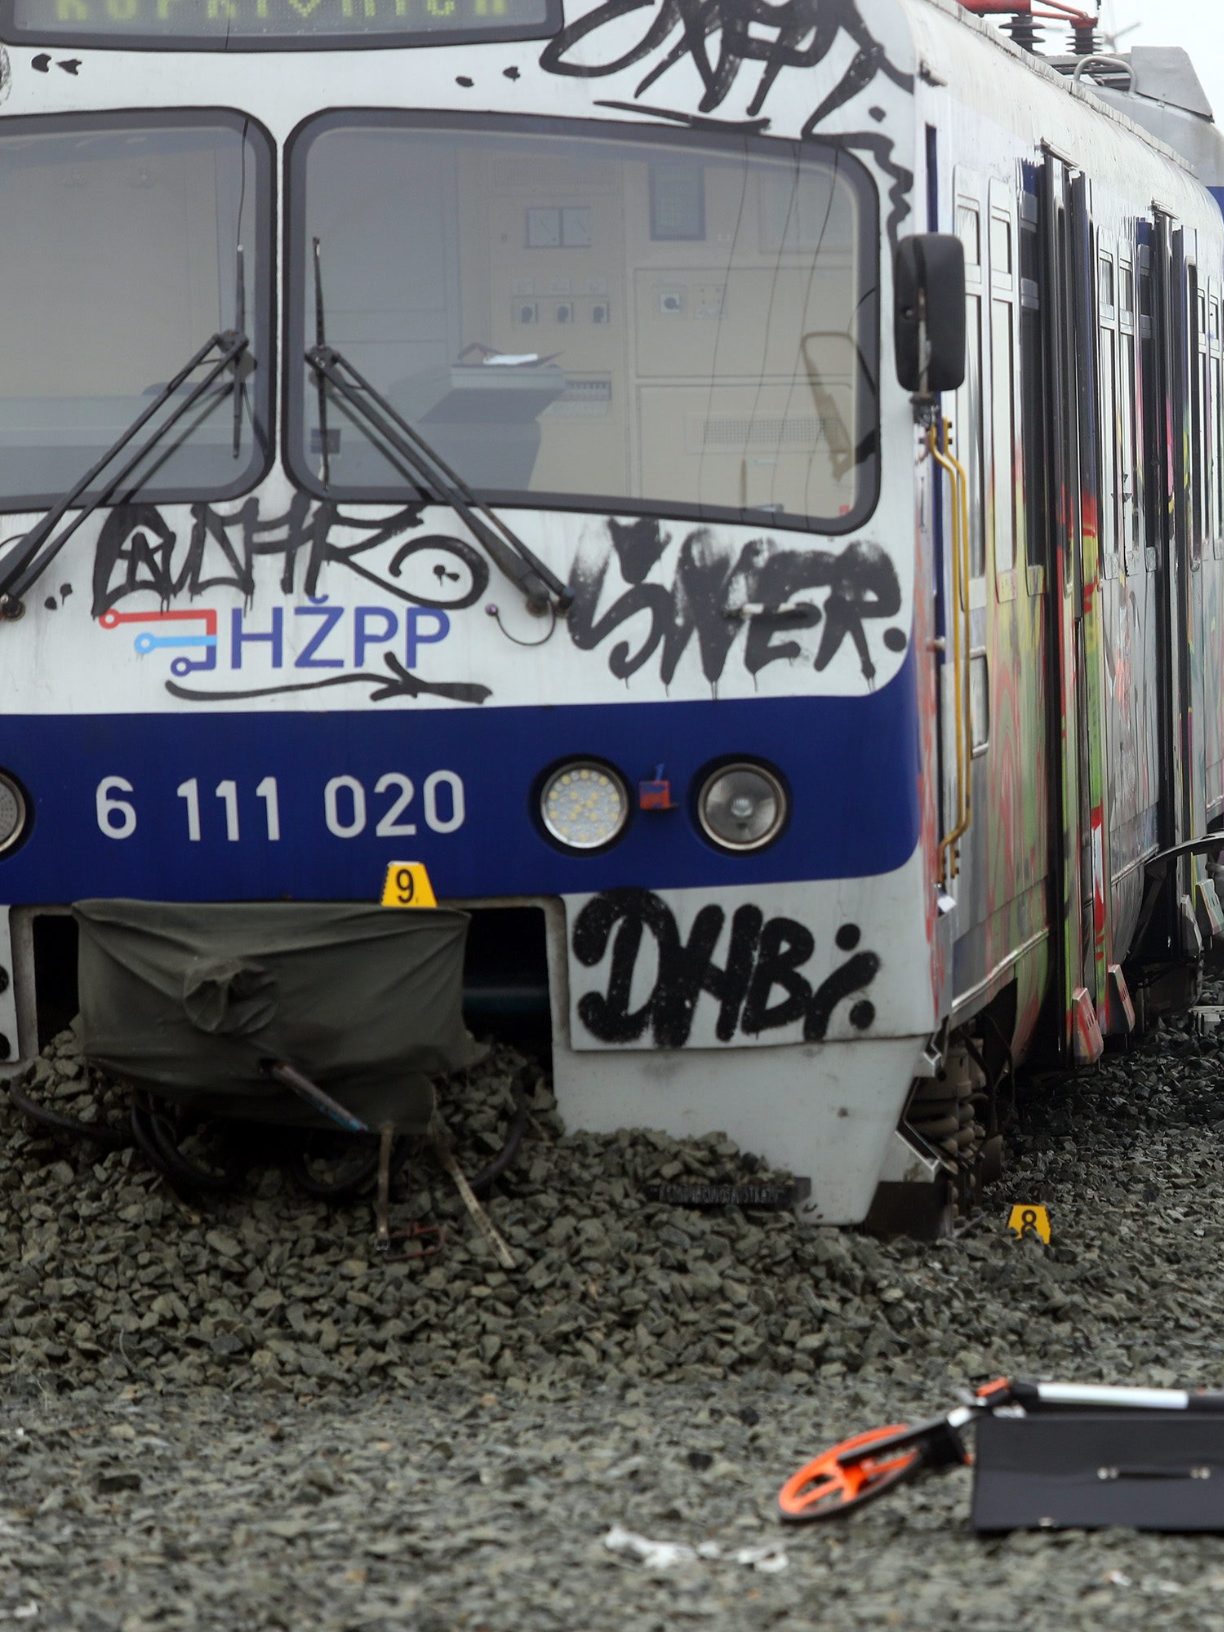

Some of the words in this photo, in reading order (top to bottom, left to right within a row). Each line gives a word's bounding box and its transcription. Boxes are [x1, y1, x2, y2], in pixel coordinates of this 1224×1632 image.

[231, 593, 451, 670] HŽPP
[96, 775, 137, 840] 6
[177, 776, 280, 841] 111
[324, 769, 466, 839] 020
[396, 868, 414, 904] 9
[1021, 1209, 1038, 1238] 8
